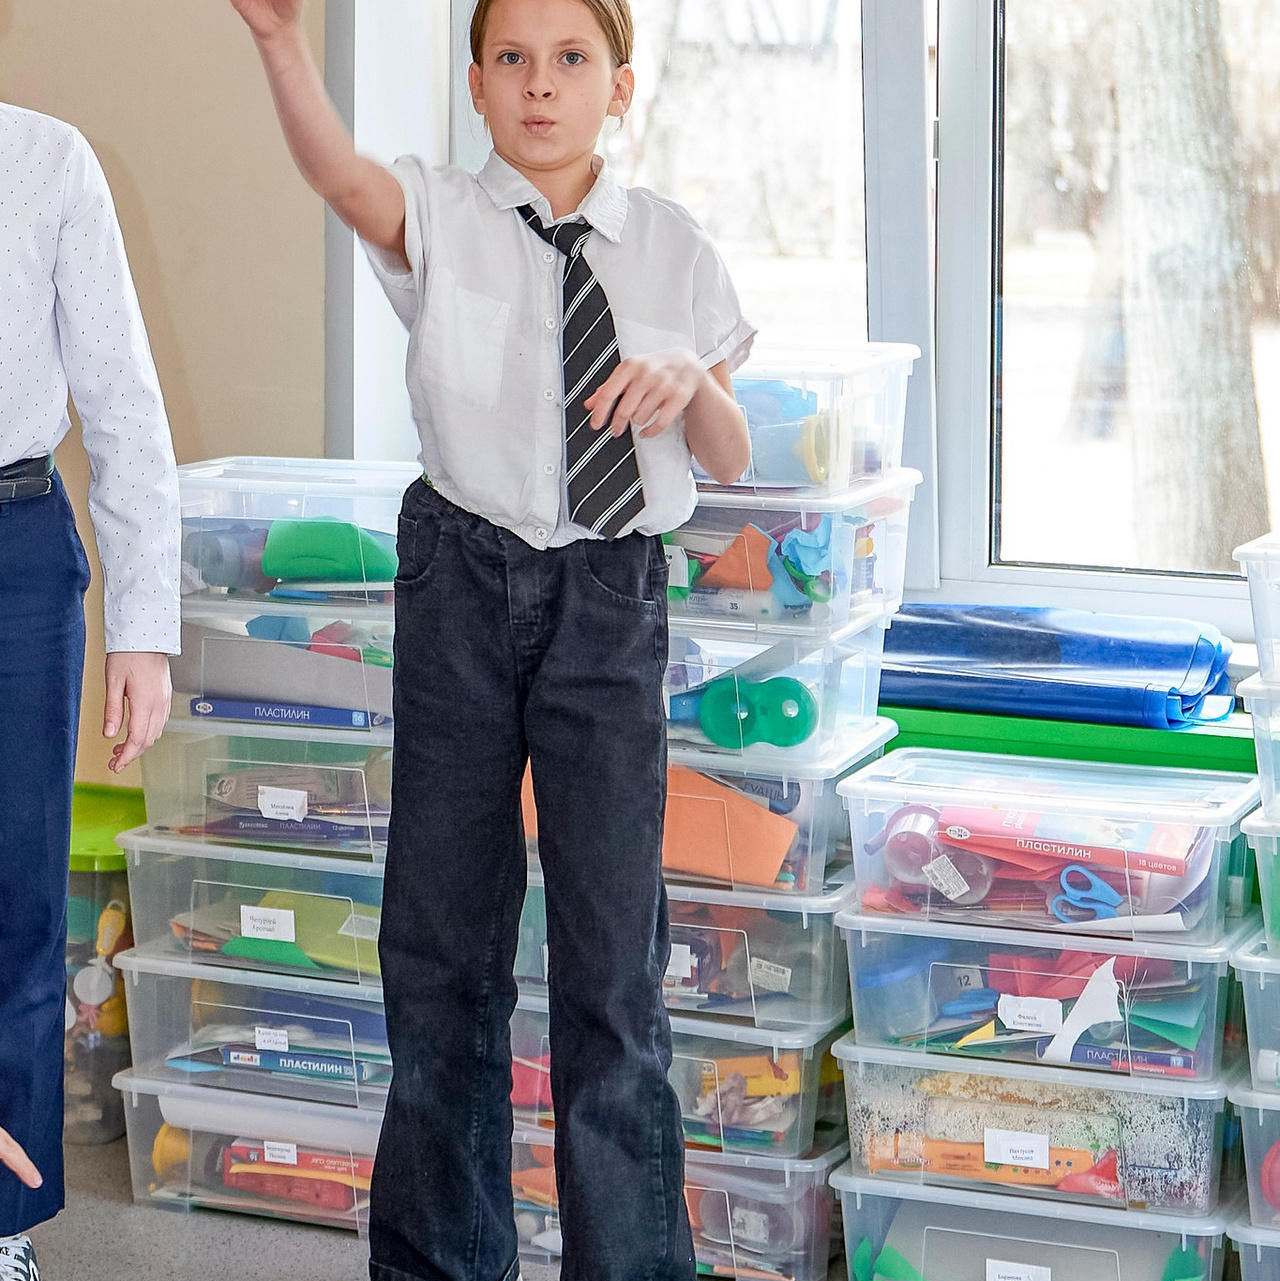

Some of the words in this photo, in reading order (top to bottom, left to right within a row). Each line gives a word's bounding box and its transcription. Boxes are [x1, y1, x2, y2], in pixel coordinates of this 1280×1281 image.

[254, 706, 310, 720] ПЛАСТИЛИН
[279, 823, 321, 831] ПЛАСТИЛИН
[1138, 858, 1147, 866] 18
[1148, 861, 1177, 871] цветов
[957, 975, 972, 988] 12
[279, 1058, 342, 1074] ПЛАСТИЛИН
[1171, 1057, 1183, 1067] 12
